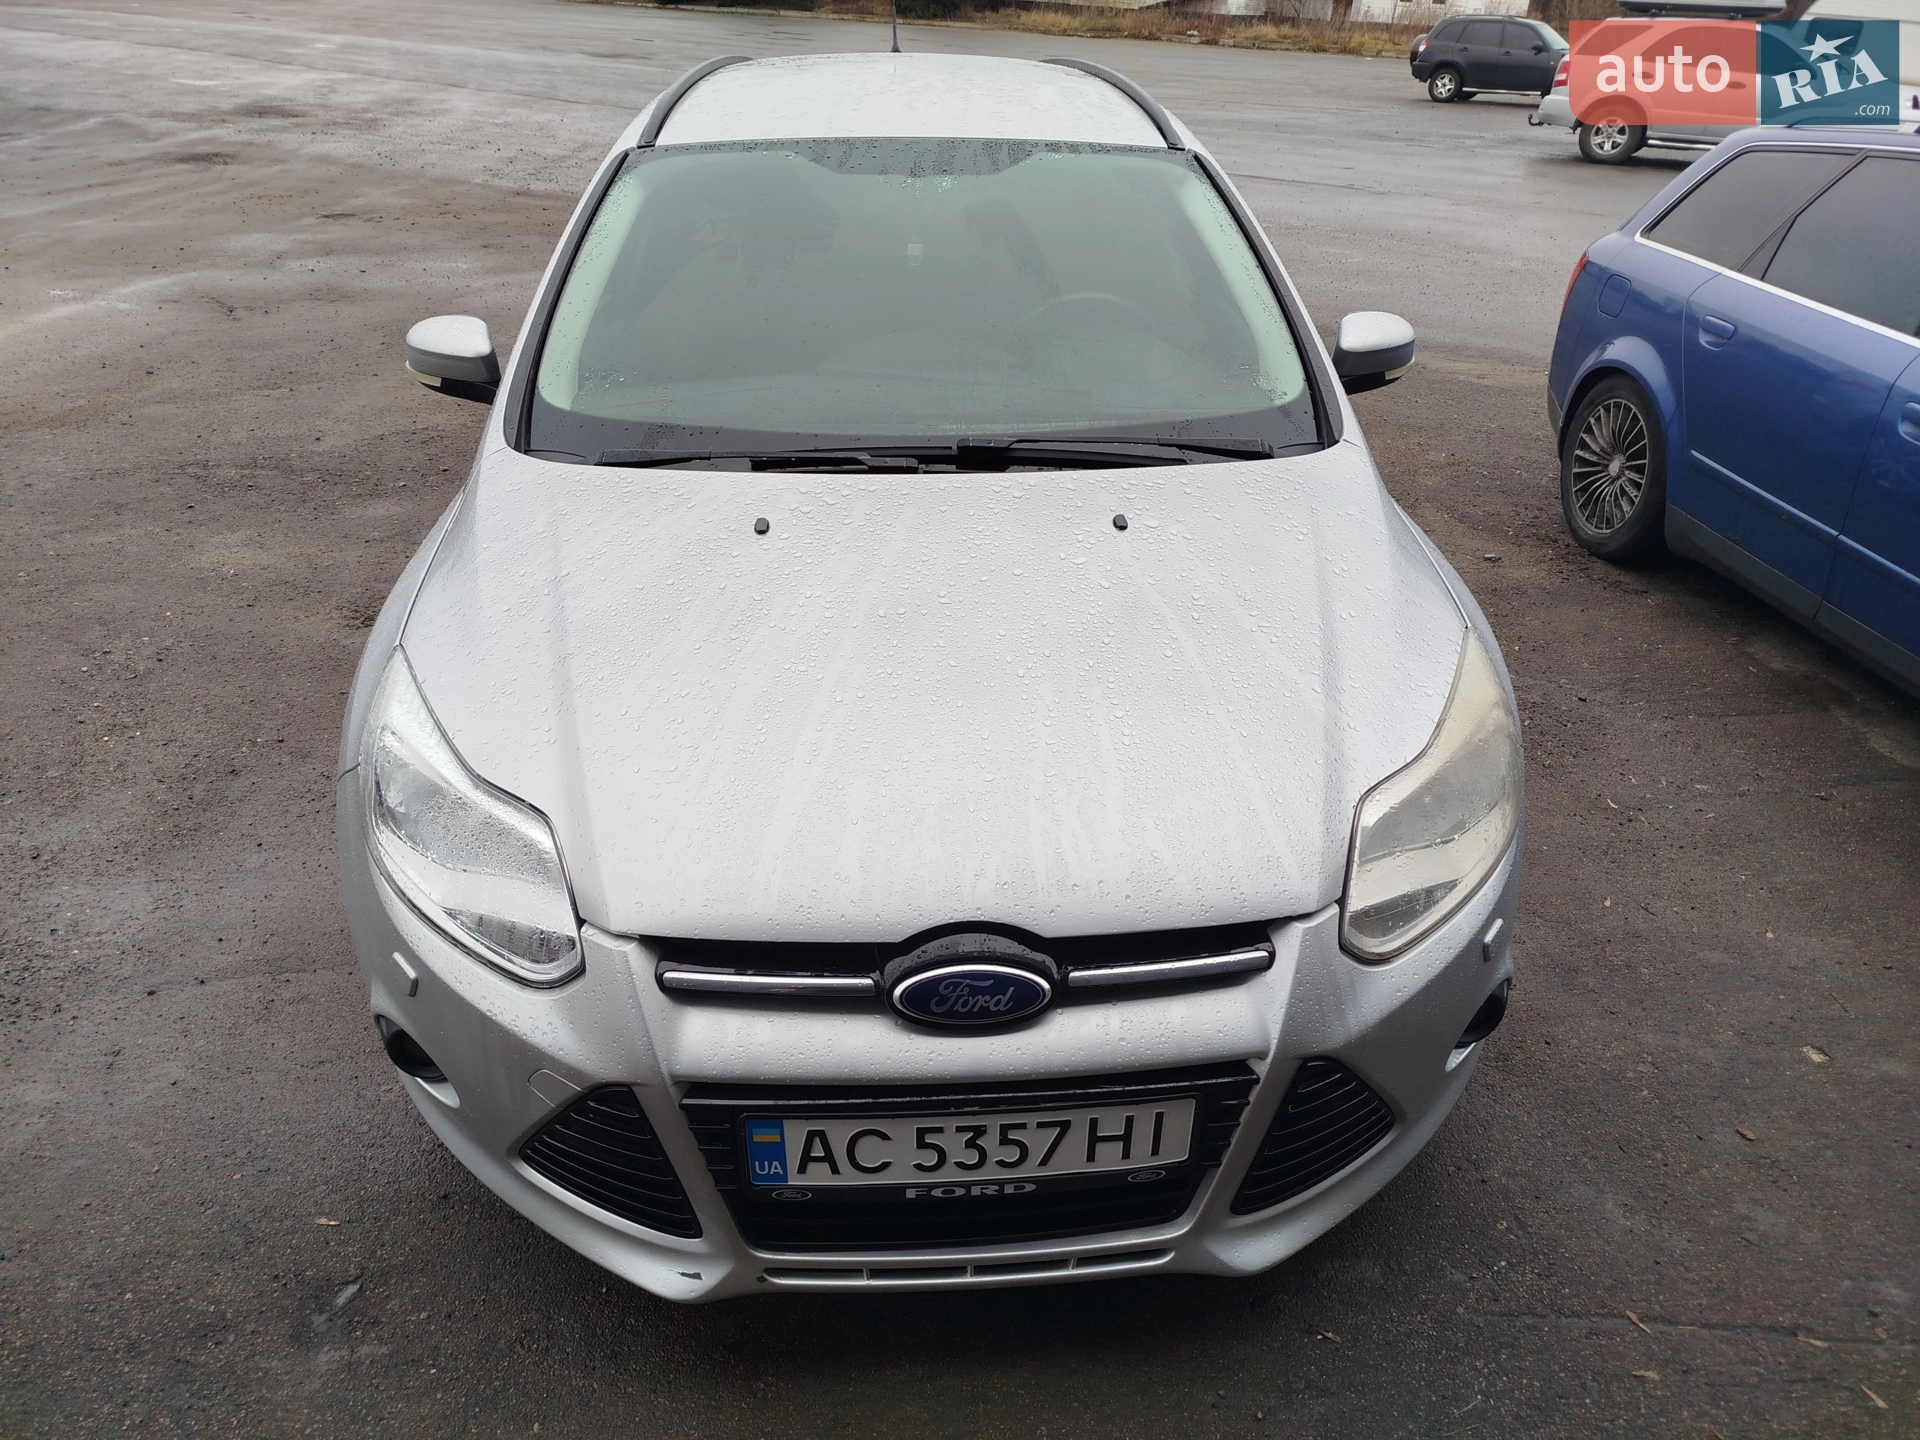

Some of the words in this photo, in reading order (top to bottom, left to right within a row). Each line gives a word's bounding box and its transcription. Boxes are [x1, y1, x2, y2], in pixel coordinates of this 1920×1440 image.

[930, 979, 1014, 1013] Ford
[795, 1127, 893, 1175] AC
[911, 1118, 1072, 1173] 5357
[1085, 1110, 1165, 1163] HI
[754, 1160, 784, 1176] UA
[906, 1182, 1037, 1198] FORD
